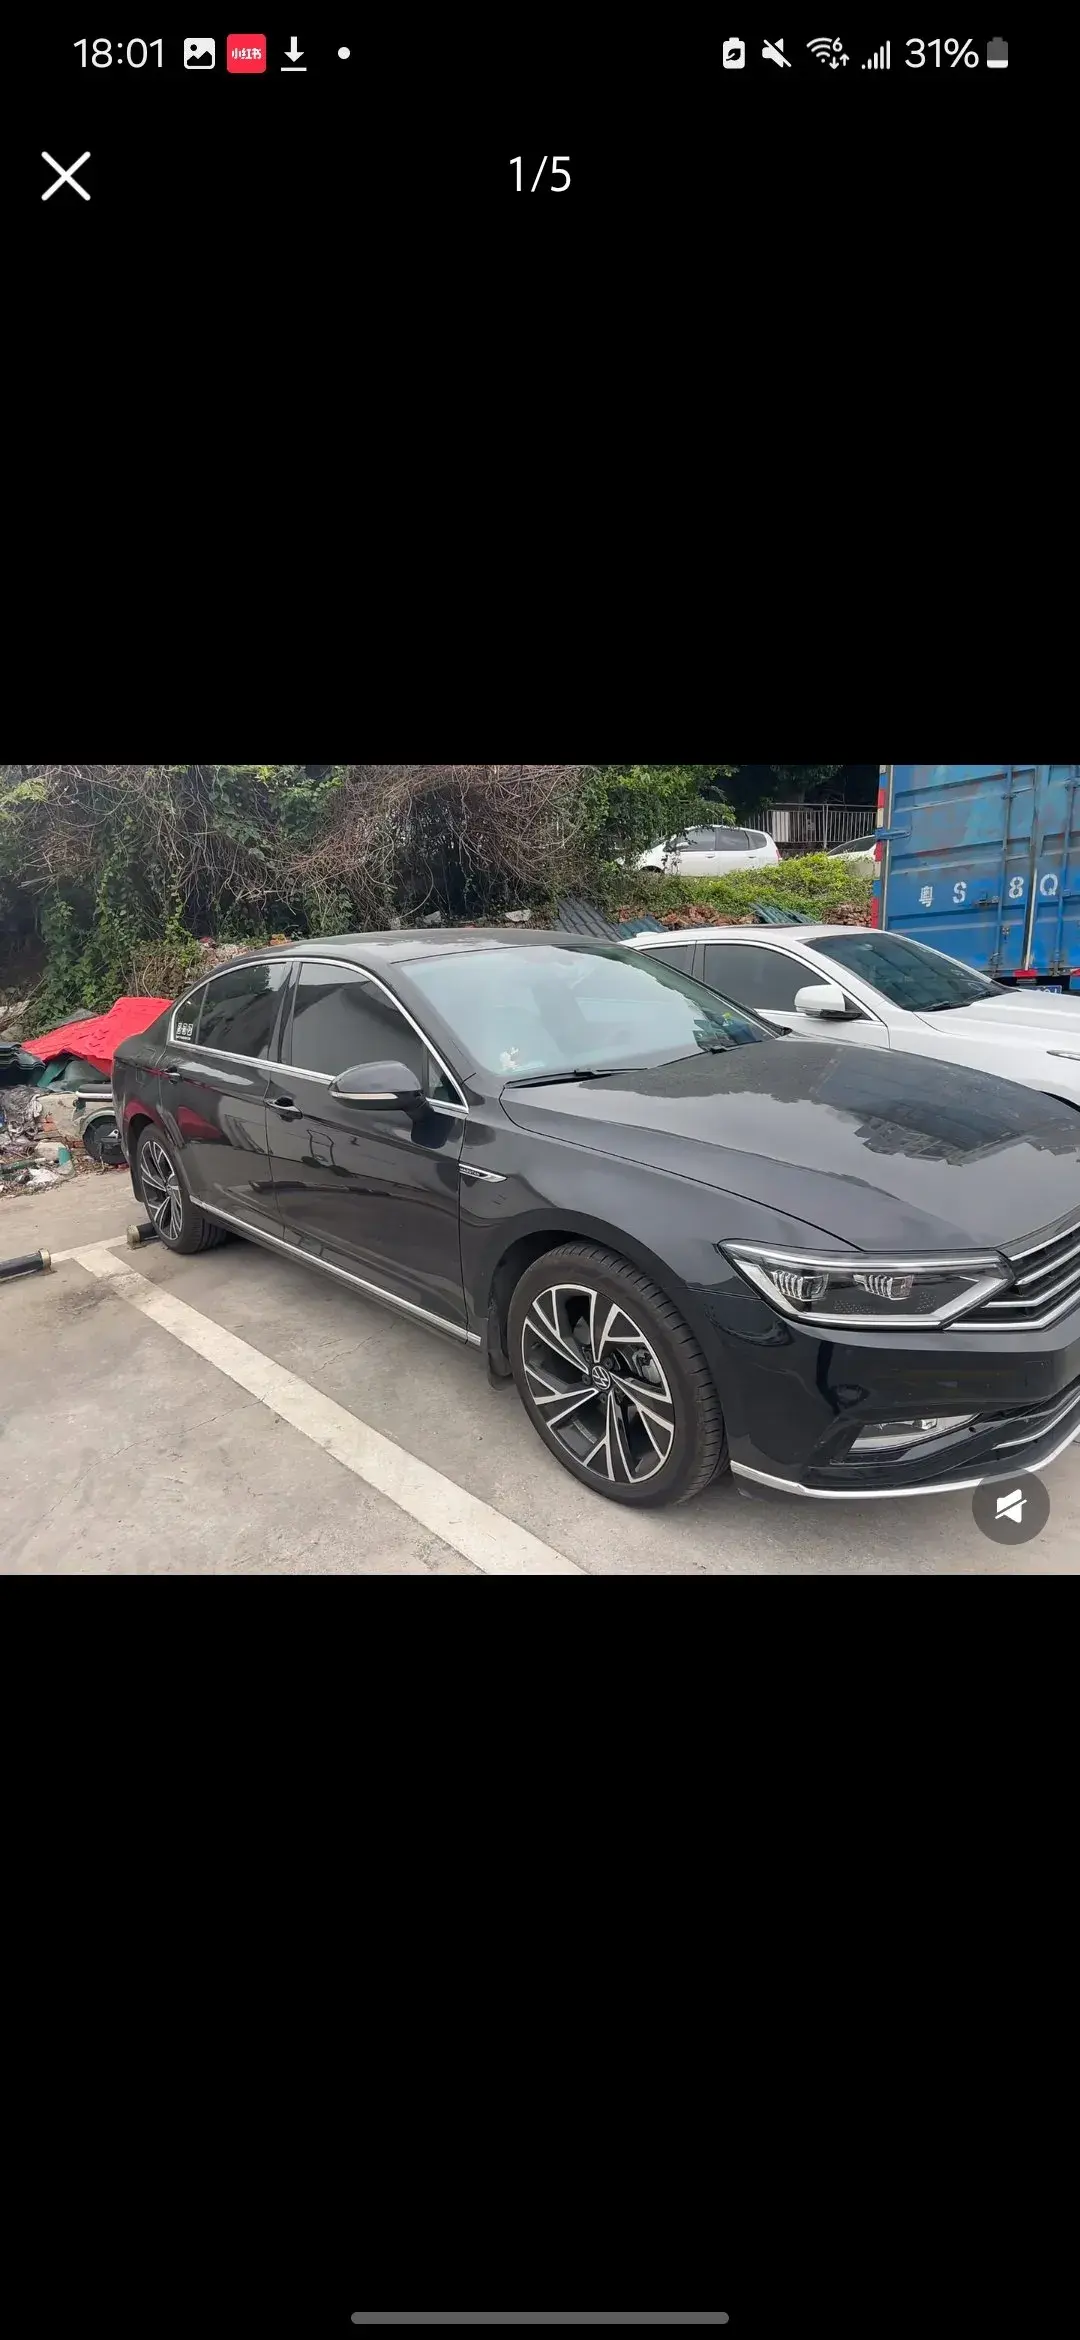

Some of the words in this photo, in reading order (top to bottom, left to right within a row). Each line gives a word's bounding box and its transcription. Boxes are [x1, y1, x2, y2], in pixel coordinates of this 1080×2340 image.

[952, 881, 967, 904] S
[1009, 876, 1024, 899] 8
[1040, 873, 1058, 896] Q
